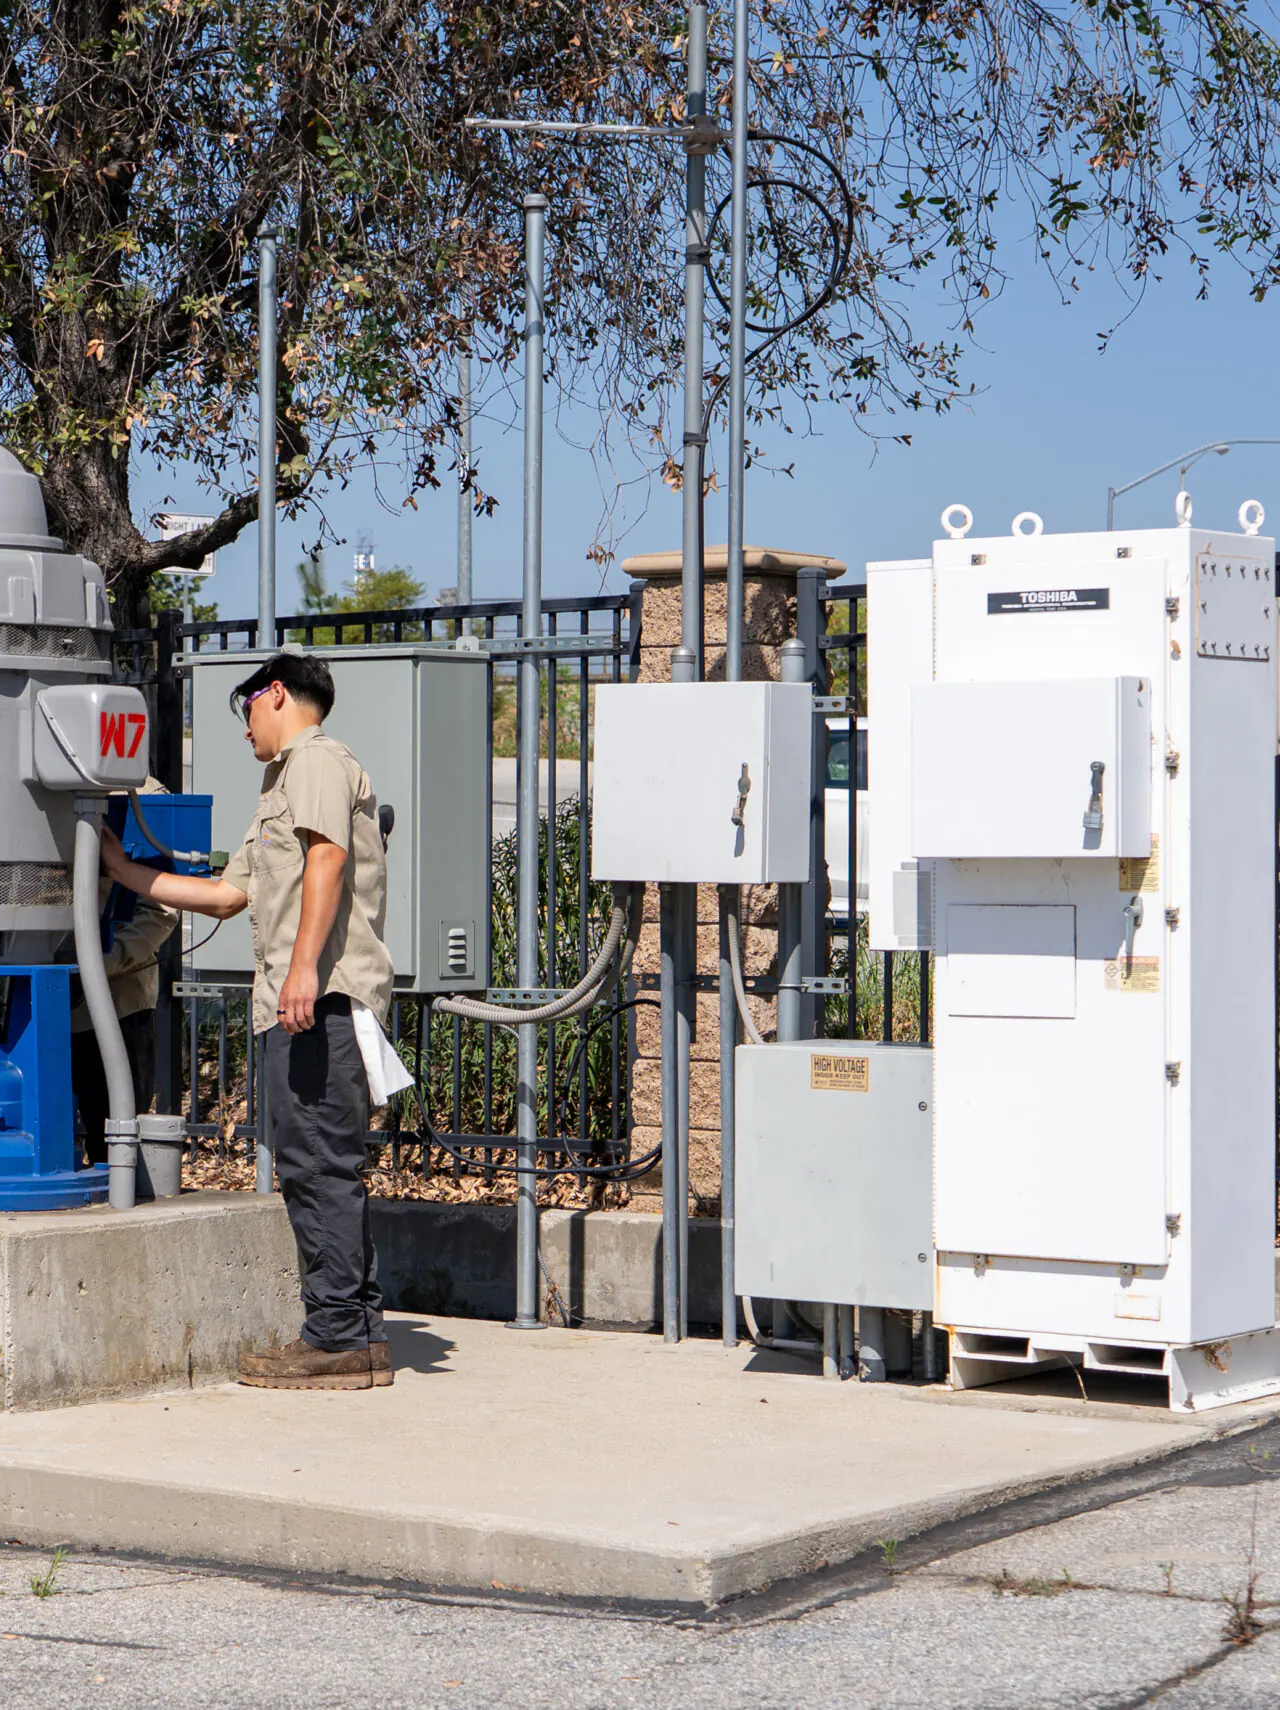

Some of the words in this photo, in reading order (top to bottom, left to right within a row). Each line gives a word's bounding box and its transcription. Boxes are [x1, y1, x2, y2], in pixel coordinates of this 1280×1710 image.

[1019, 591, 1078, 604] TOSHIBA
[101, 711, 146, 758] W7
[814, 1057, 832, 1072] HIGH
[833, 1058, 865, 1073] VOLTAGE
